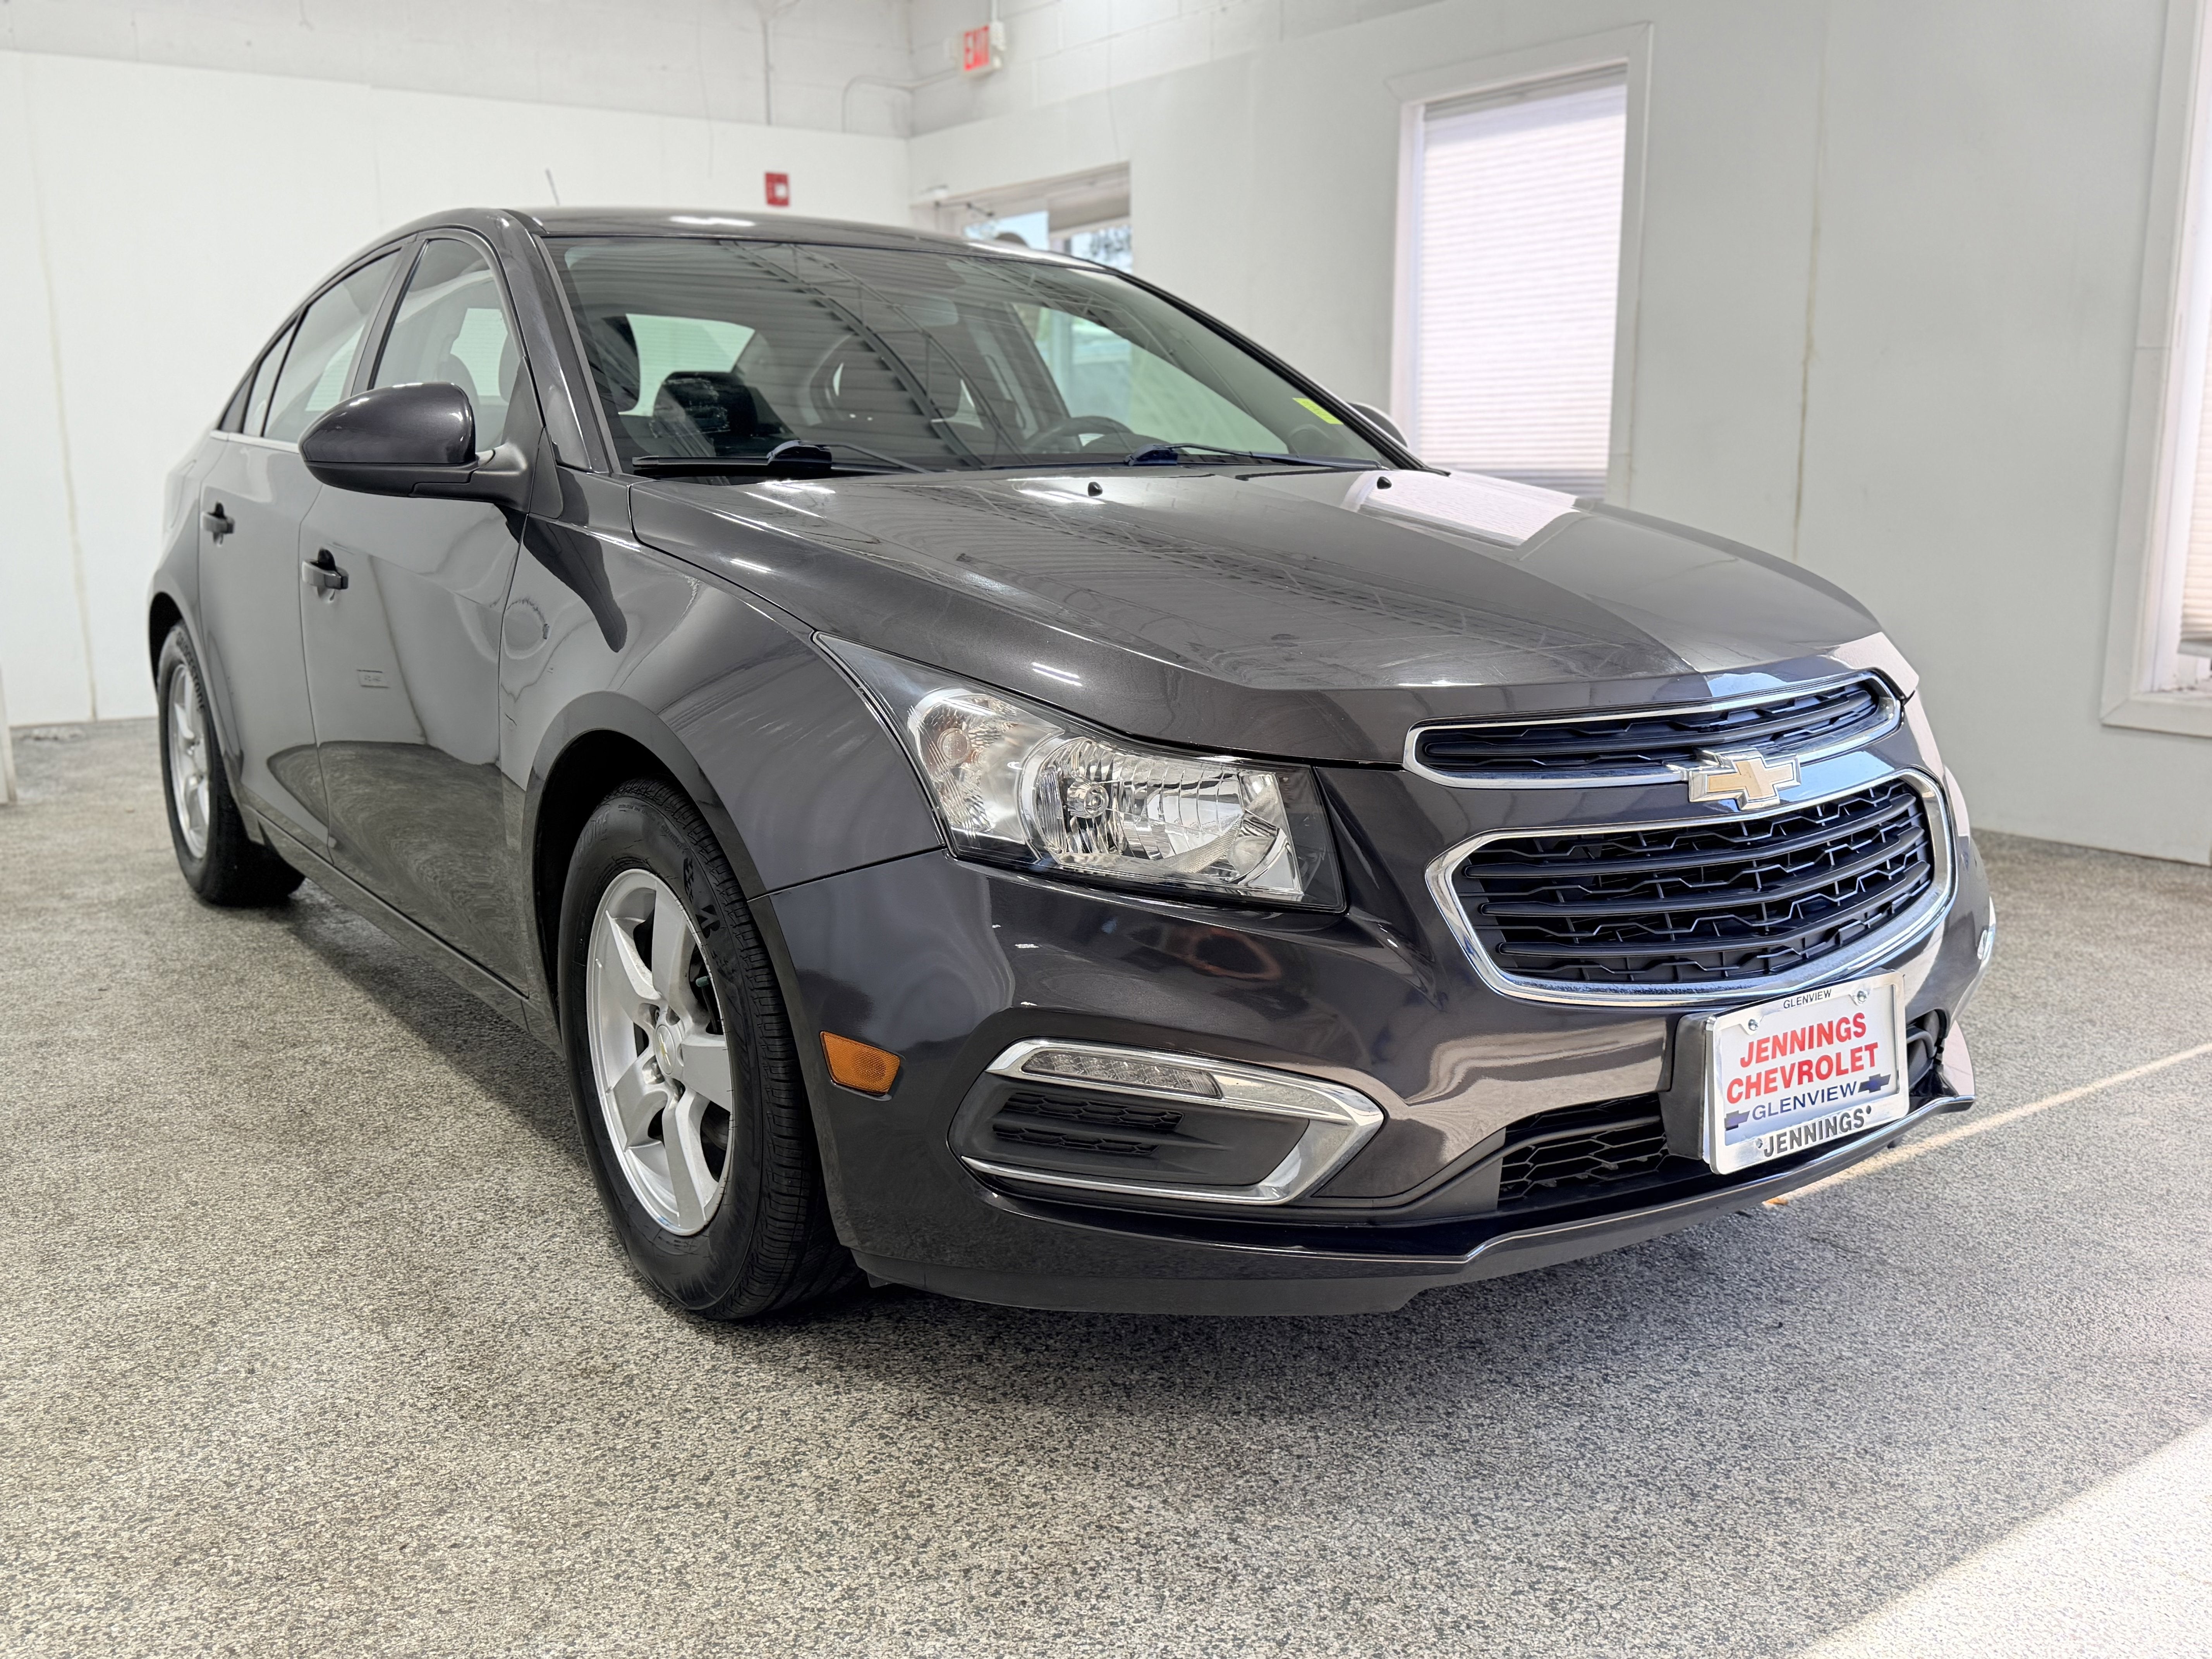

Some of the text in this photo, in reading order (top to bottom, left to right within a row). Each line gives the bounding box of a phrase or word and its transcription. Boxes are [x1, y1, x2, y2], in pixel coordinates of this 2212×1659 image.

[964, 25, 990, 71] EXIT
[1783, 989, 1832, 1009] GLENVIEW
[1740, 1012, 1866, 1068] JENNINGS
[1726, 1042, 1878, 1104] CHEVROLET
[1752, 1081, 1857, 1120] GLENVIEW
